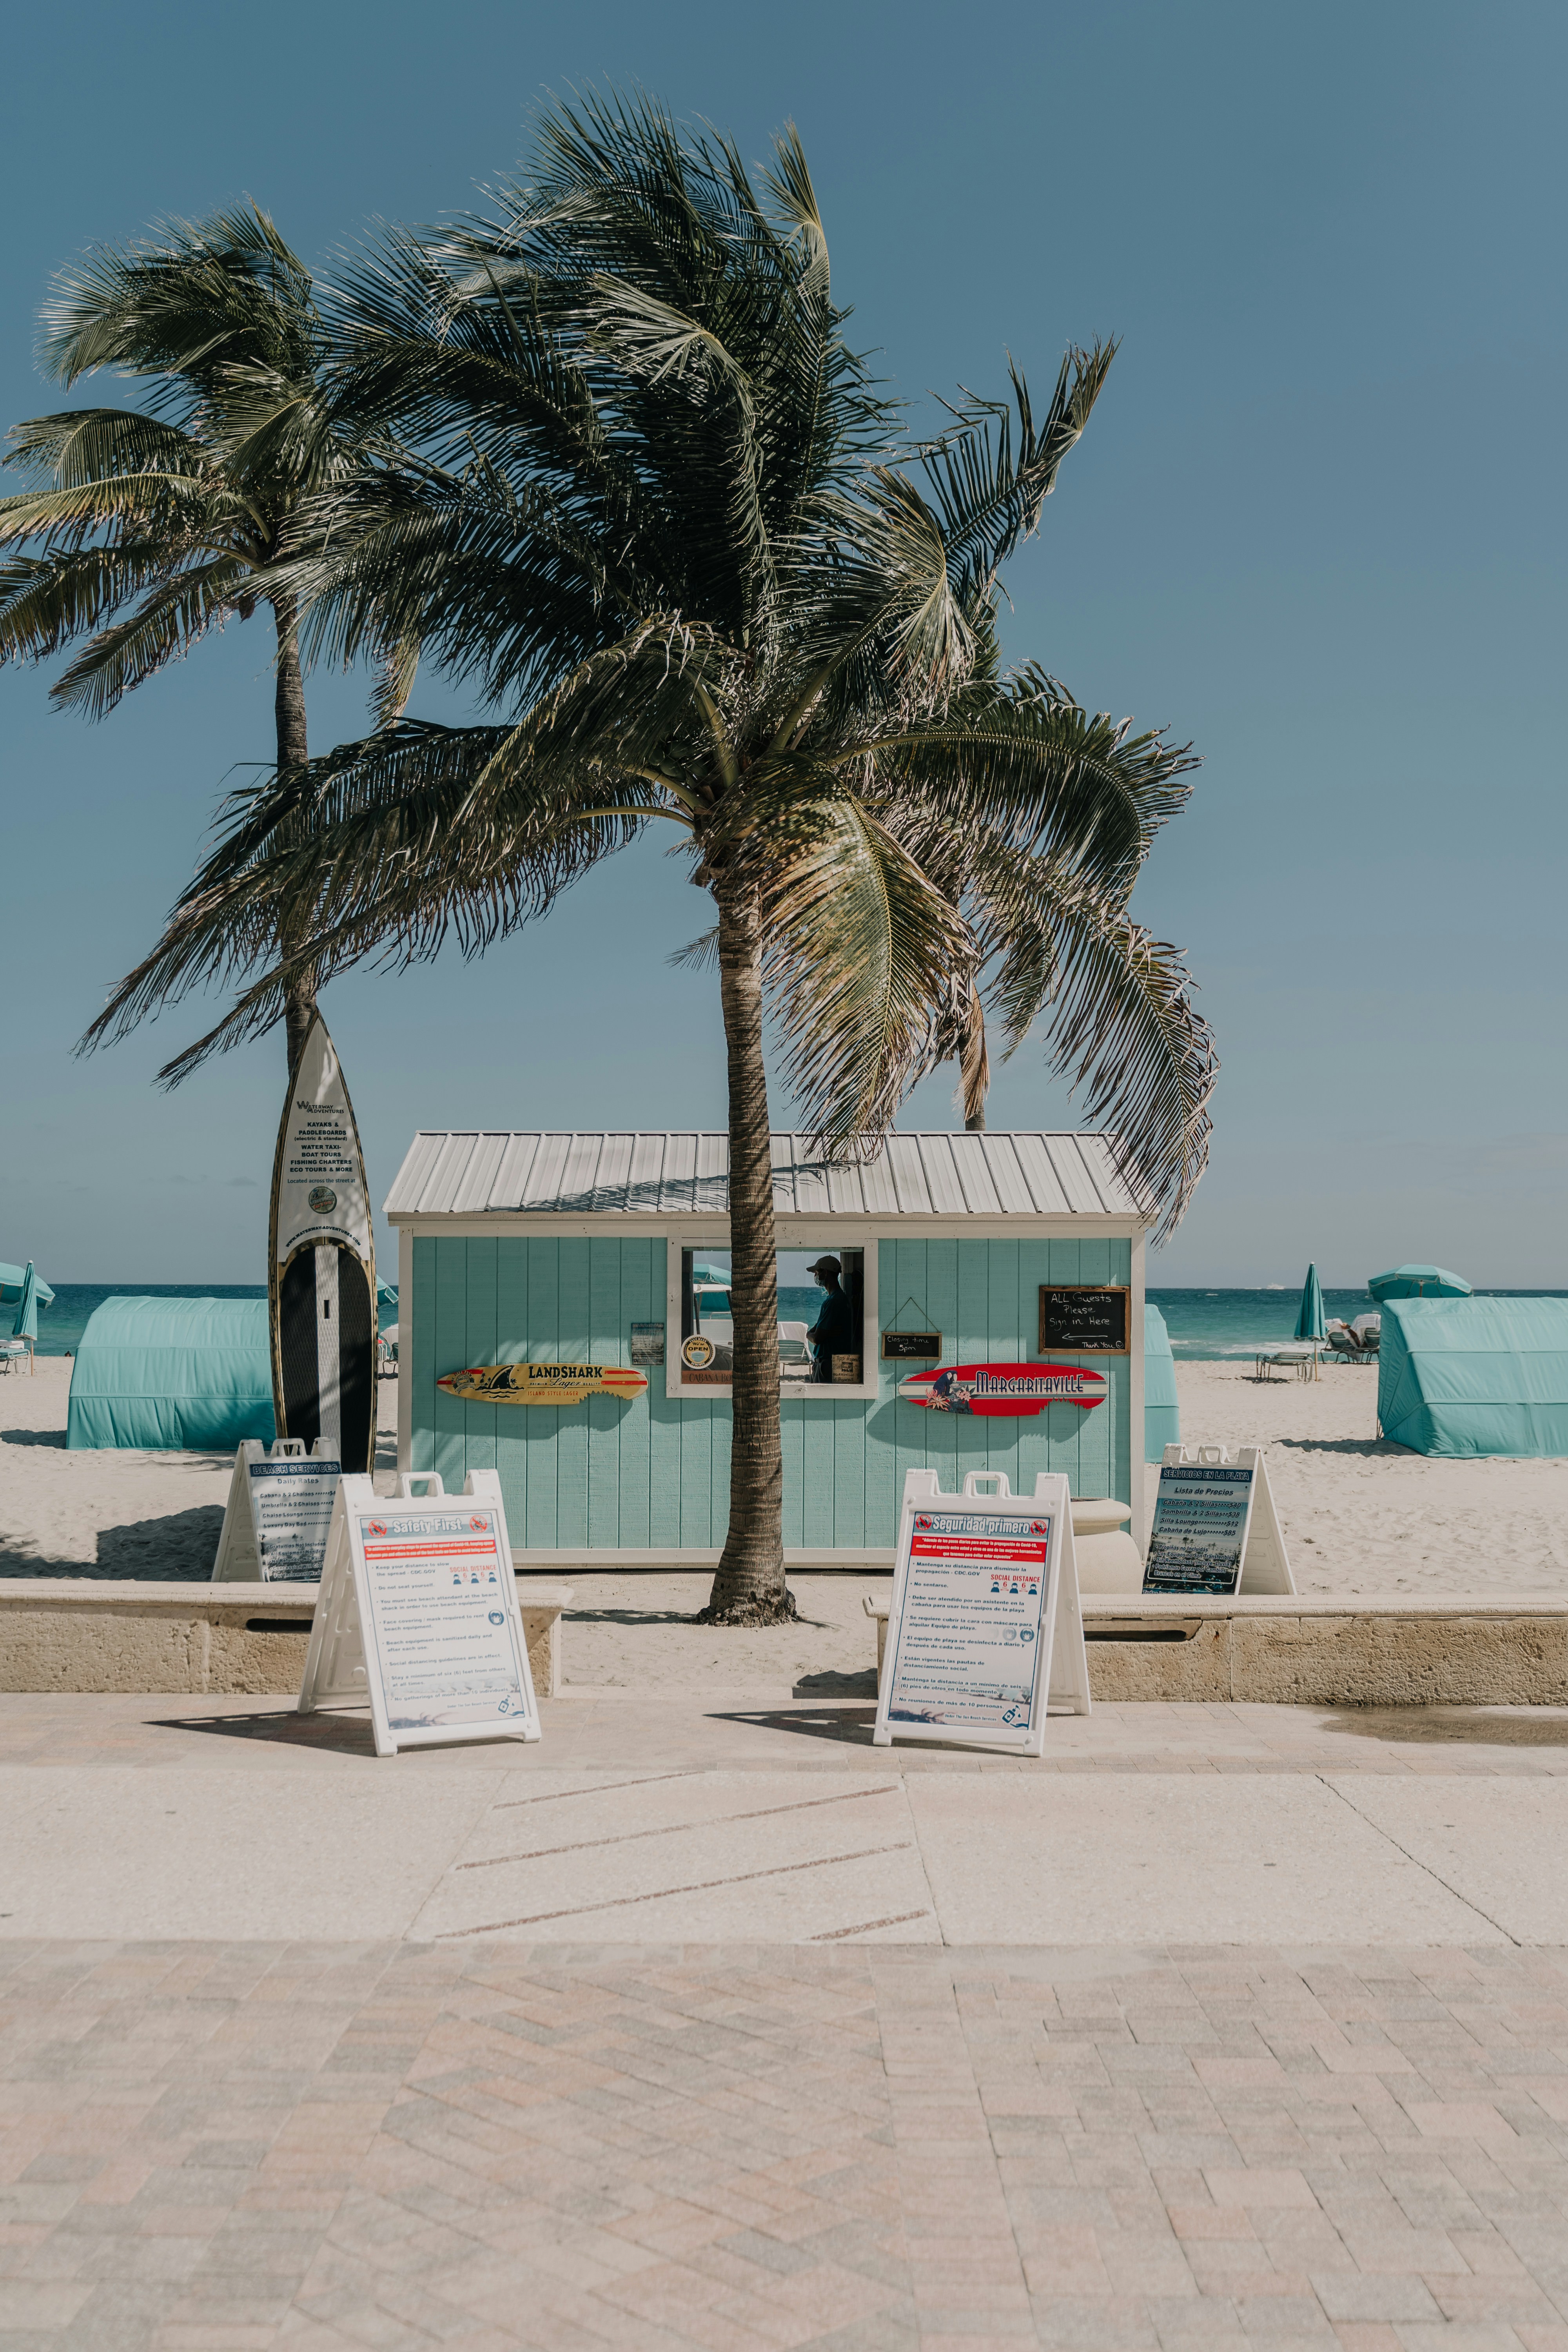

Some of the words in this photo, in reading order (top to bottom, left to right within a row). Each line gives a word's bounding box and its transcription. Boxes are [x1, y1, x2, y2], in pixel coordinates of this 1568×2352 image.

[296, 1101, 333, 1109] WATERWAY
[307, 1105, 344, 1114] ADVENTURES
[285, 1226, 361, 1247] WWW.WATERWAY-ADVENTURES.COM
[1051, 1293, 1069, 1303] ALL
[1073, 1292, 1111, 1302] Guests
[1063, 1305, 1096, 1314] Please
[1049, 1318, 1067, 1331] Sign
[1089, 1316, 1109, 1325] Here
[887, 1336, 908, 1345] Closing
[529, 1366, 603, 1379] LANDSHARK
[689, 1373, 718, 1383] CABANA
[550, 1377, 581, 1389] Lager
[975, 1370, 1083, 1394] MARGARITAVILLE
[253, 1465, 288, 1474] BEACH
[289, 1464, 338, 1473] SERVICES
[1163, 1470, 1201, 1478] SERVICIOS
[1226, 1472, 1249, 1480] PLAYA
[392, 1519, 431, 1534] Safety
[434, 1518, 463, 1532] First
[933, 1515, 987, 1534] Seguridad
[988, 1518, 1030, 1535] primero
